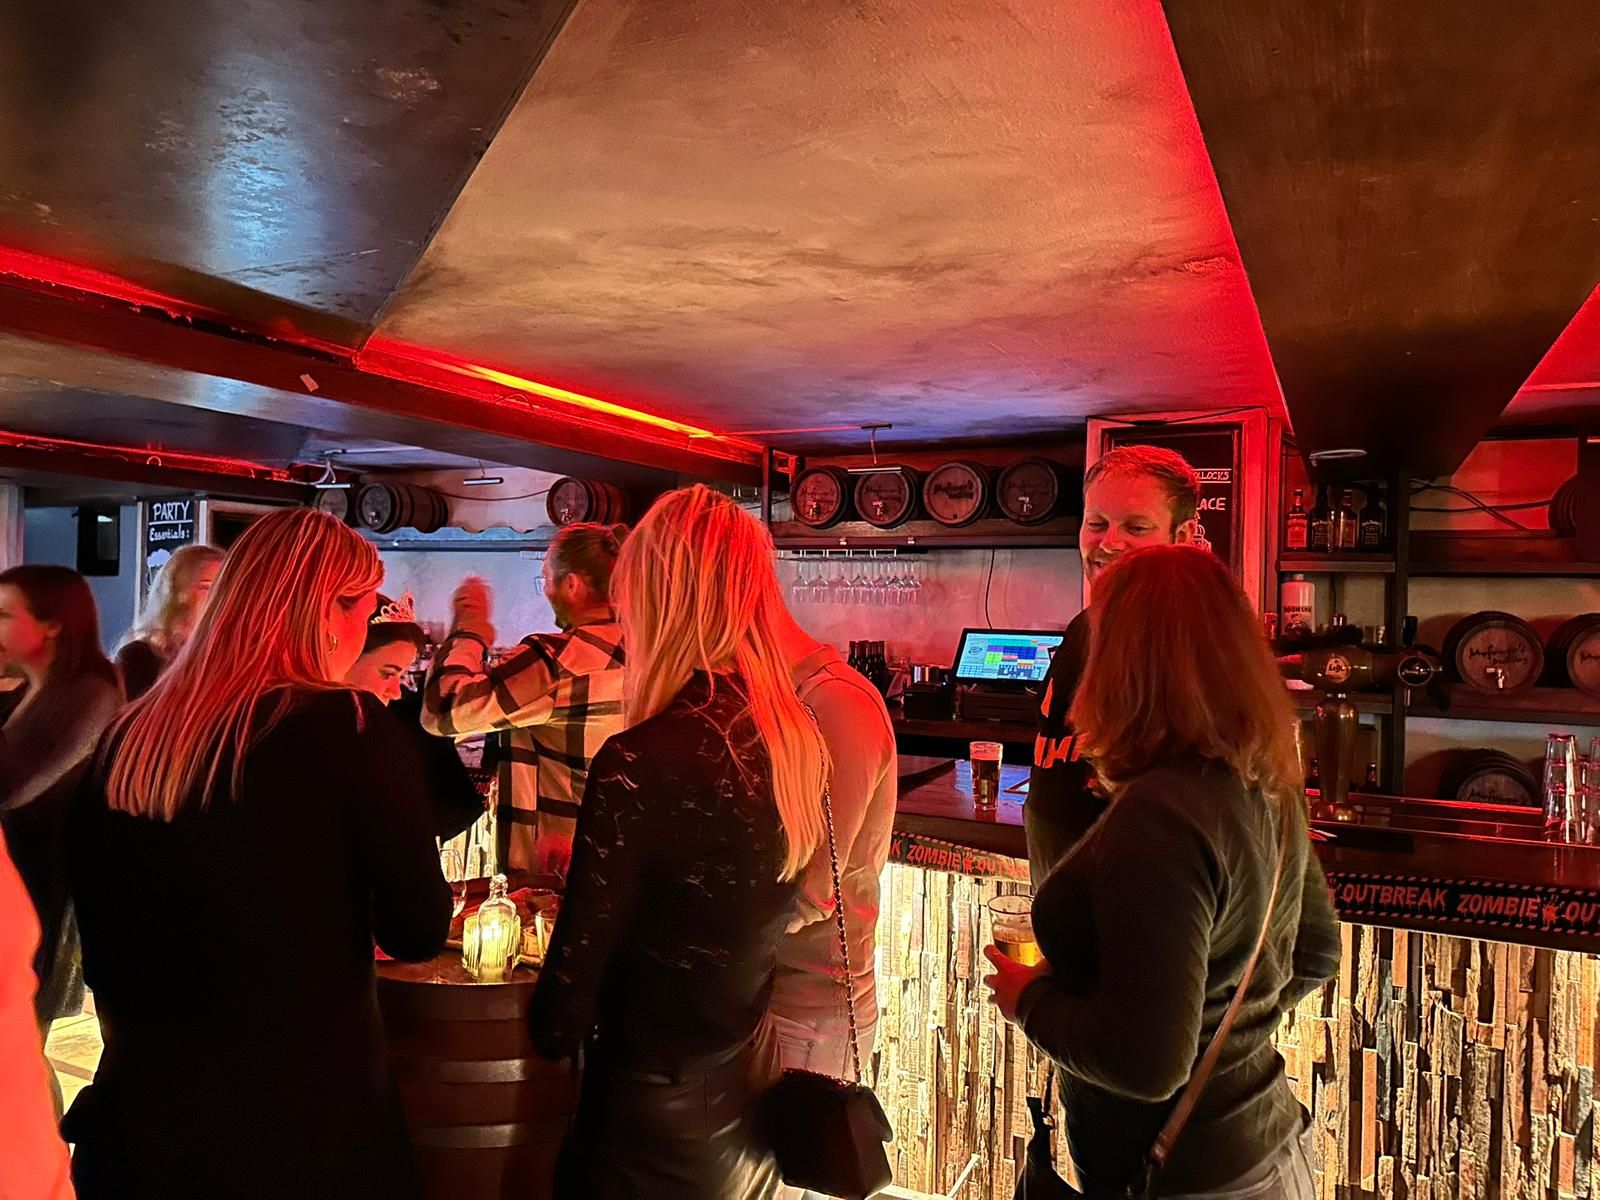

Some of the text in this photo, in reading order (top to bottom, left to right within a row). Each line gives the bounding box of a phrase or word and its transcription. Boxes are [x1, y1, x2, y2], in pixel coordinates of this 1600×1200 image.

[152, 500, 190, 521] PARTY
[907, 844, 961, 869] ZOMBIE
[1342, 882, 1448, 907] OUTBREAK
[1457, 894, 1539, 918] ZOMBIE
